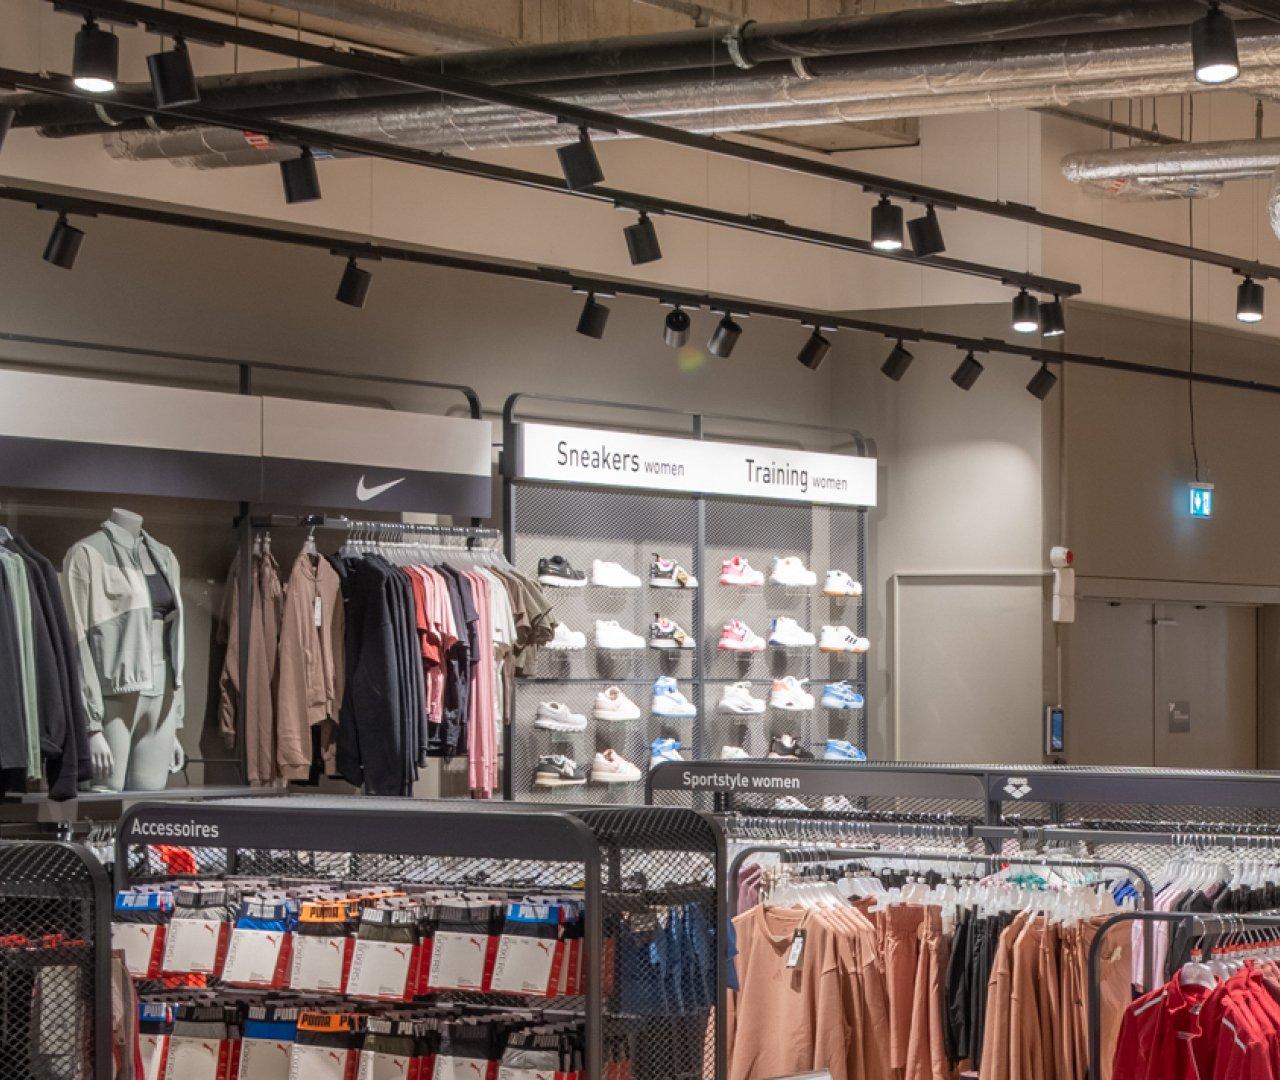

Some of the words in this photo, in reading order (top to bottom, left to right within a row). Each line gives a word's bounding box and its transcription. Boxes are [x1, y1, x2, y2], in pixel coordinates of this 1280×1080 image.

[556, 441, 640, 472] Sneakers
[644, 460, 685, 477] women
[745, 458, 808, 493] Training
[812, 475, 848, 491] women
[682, 771, 749, 790] Sportstyle
[751, 777, 801, 789] women
[131, 817, 219, 838] Accessoires
[300, 1013, 331, 1028] PUMA
